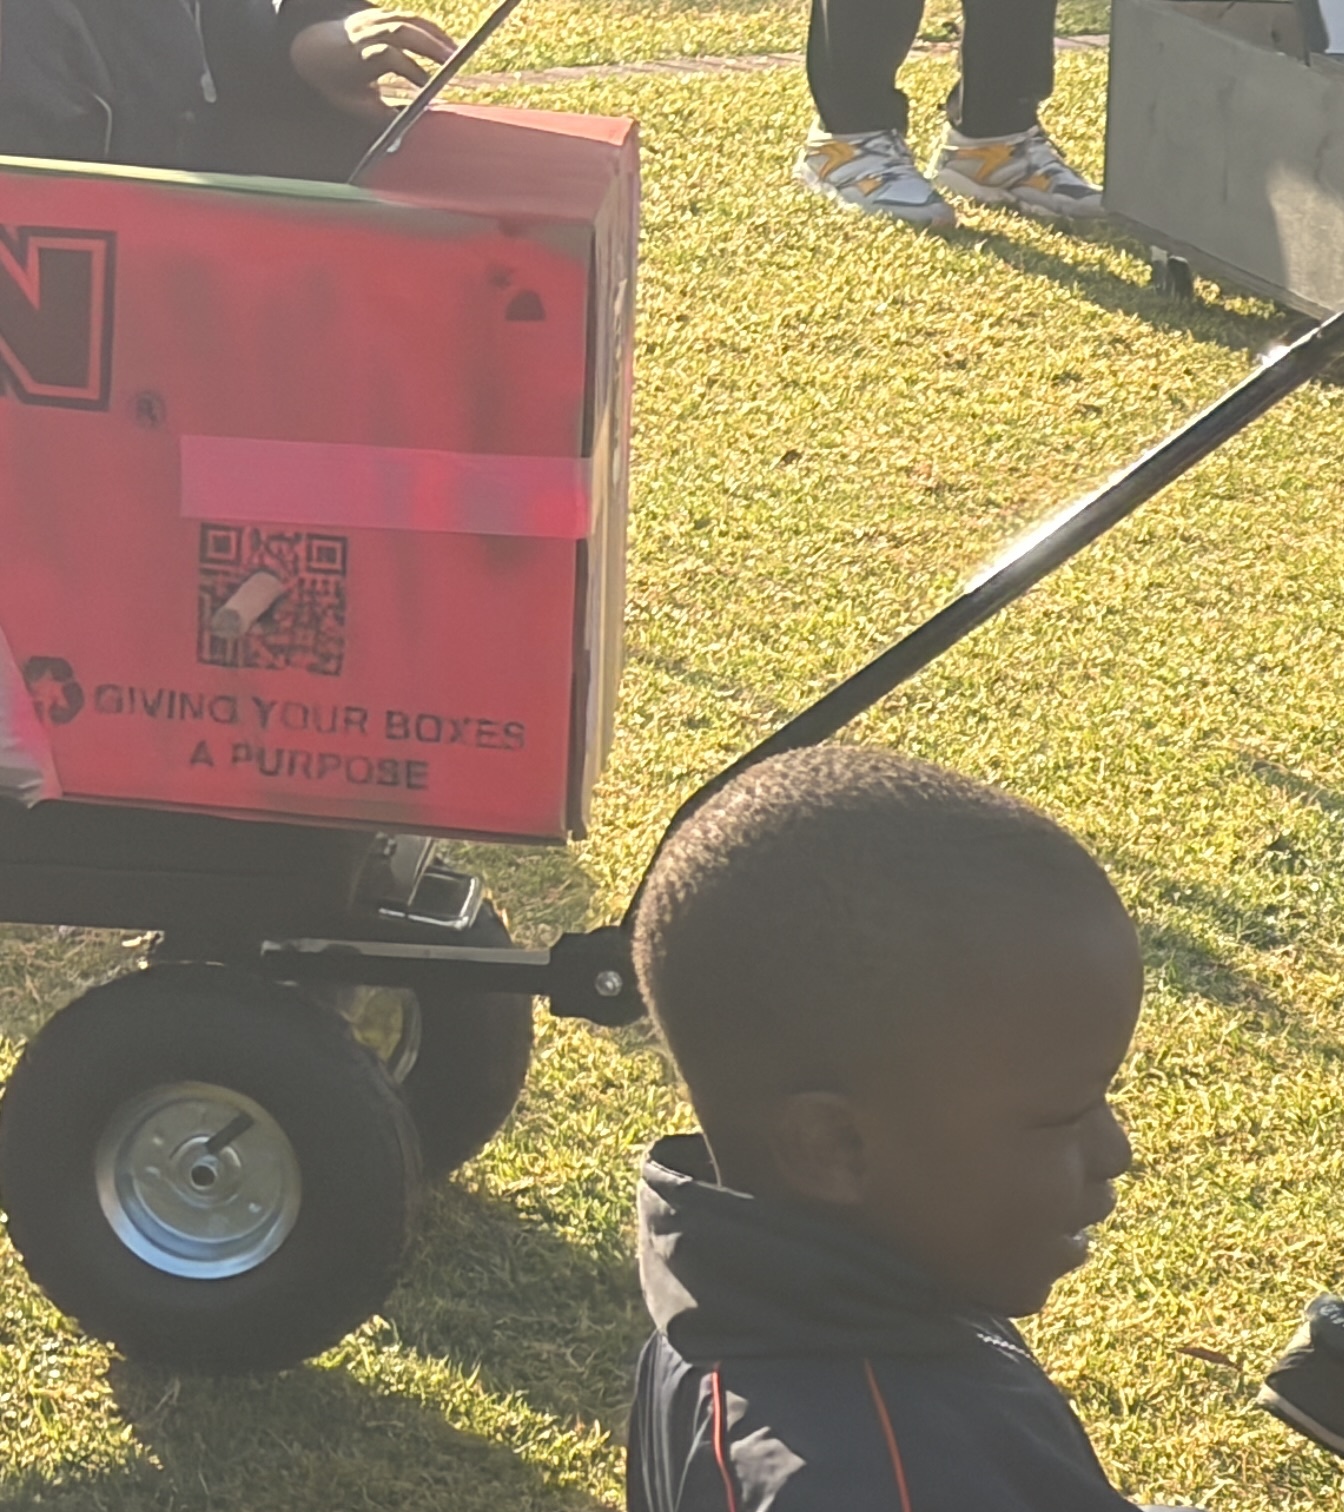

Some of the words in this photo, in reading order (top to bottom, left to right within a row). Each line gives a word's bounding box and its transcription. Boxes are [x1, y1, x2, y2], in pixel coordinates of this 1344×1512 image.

[95, 684, 238, 724] GIVING
[252, 696, 368, 734] YOUR
[386, 710, 525, 751] BOXES
[190, 740, 214, 767] A
[232, 743, 429, 789] PURPOSE
